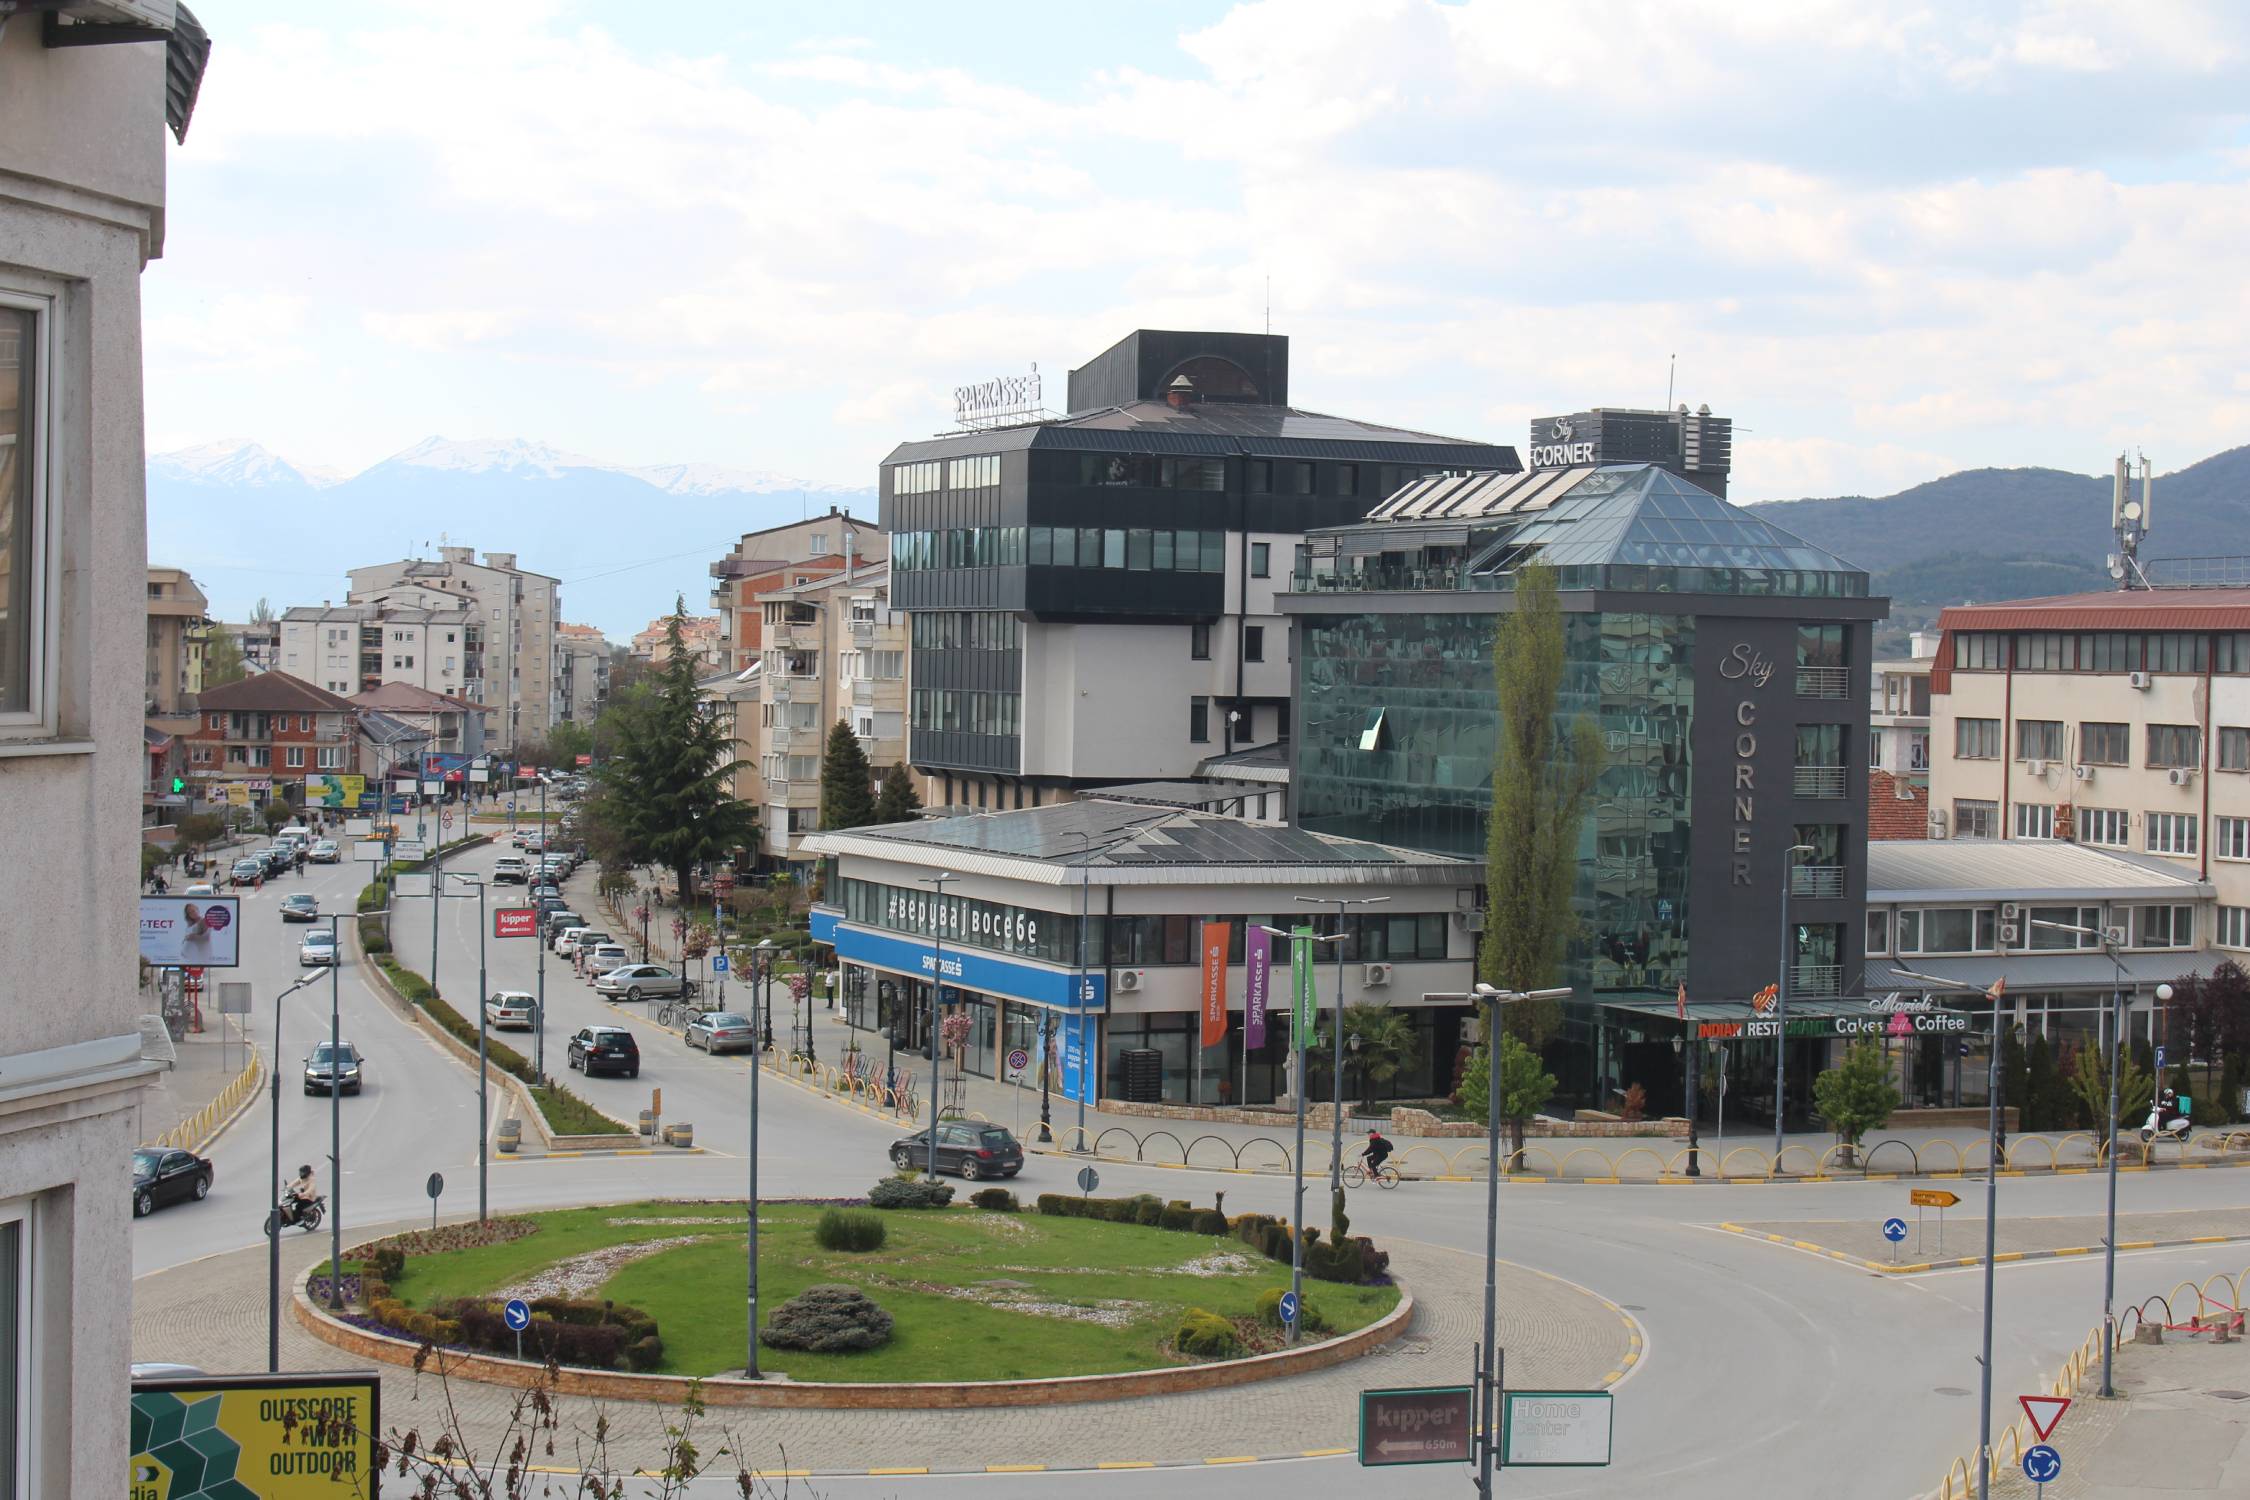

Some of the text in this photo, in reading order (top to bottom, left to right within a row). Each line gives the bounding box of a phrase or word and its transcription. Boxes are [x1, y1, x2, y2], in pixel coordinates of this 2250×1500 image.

[954, 376, 1027, 413] SPARKASSE
[1551, 417, 1575, 442] Sky
[1533, 442, 1594, 467] CORNER
[1719, 643, 1775, 688] Sky
[1732, 701, 1757, 886] CORNER
[501, 913, 531, 925] kipper
[922, 955, 955, 975] SPAASSE
[1210, 959, 1219, 1022] SPARKASSE
[1252, 961, 1263, 1025] SPARKASSE
[1698, 1020, 1825, 1038] INDIAN RESTURANT
[1835, 1015, 1965, 1034] Cakes Coffee
[260, 1397, 357, 1422] OUTSCORE
[1377, 1404, 1458, 1432] kipper
[1514, 1400, 1581, 1418] Home
[1514, 1420, 1571, 1437] Center
[1425, 1439, 1457, 1451] 650m
[270, 1451, 357, 1475] OUTDOOR
